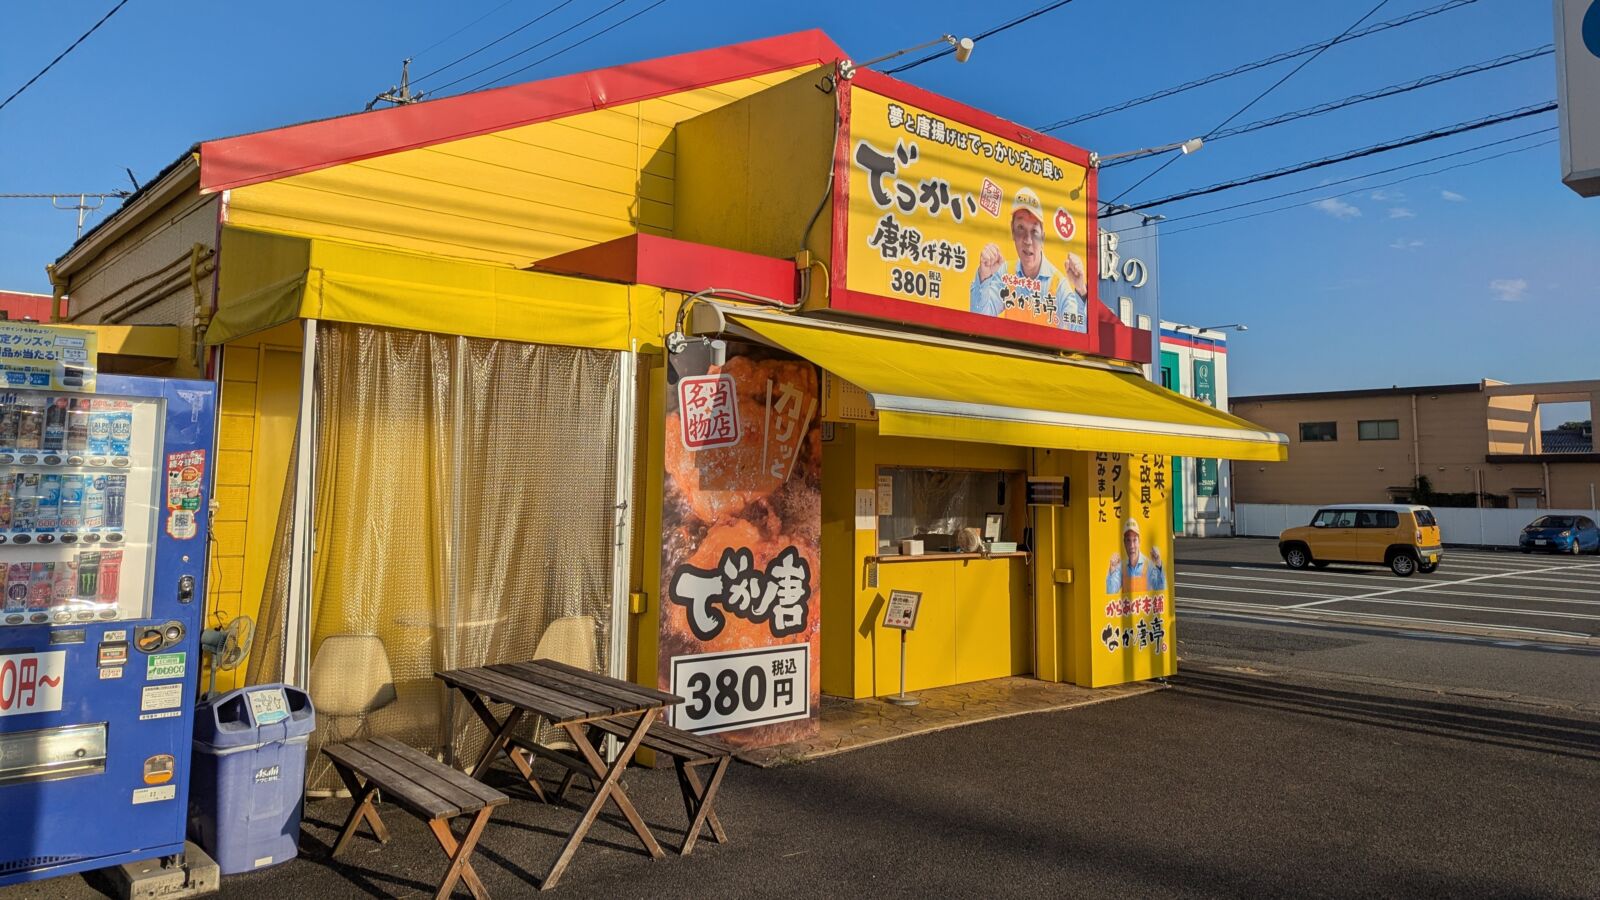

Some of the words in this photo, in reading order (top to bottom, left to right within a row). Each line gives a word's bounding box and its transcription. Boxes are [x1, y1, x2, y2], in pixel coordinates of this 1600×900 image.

[855, 139, 977, 222] でっかい
[888, 104, 1064, 181] 夢と唐揚げはでっかい方が良い
[870, 215, 967, 270] 唐揚げ弁当
[770, 382, 803, 479] カリッと
[672, 549, 809, 639] でか唐
[1105, 596, 1164, 616] からあげ本舗
[772, 659, 797, 676] 税込
